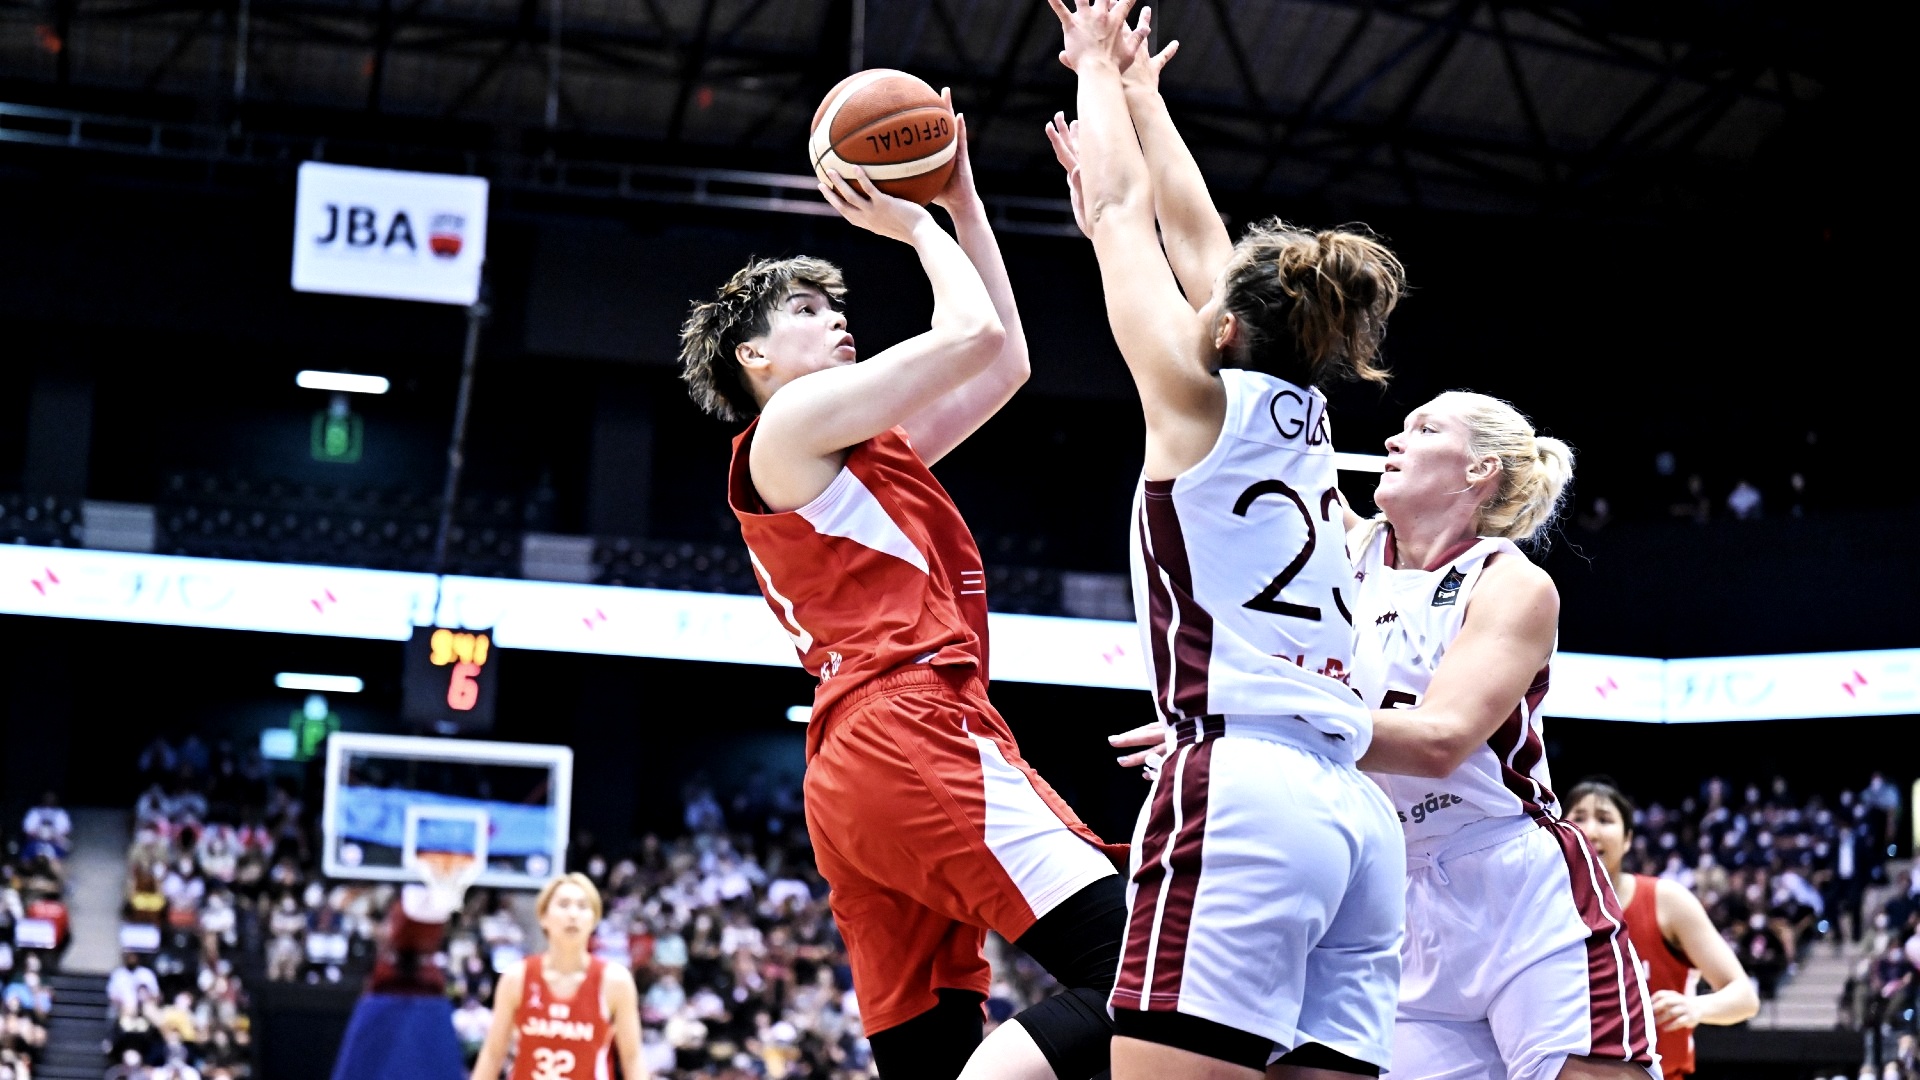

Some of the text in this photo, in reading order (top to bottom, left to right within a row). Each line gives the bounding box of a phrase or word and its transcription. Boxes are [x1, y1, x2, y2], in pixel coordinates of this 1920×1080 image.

[867, 117, 949, 154] OFFICIAL
[316, 204, 417, 251] JBA
[447, 661, 481, 710] 6
[521, 1016, 595, 1042] JAPAN
[531, 1047, 577, 1080] 32
